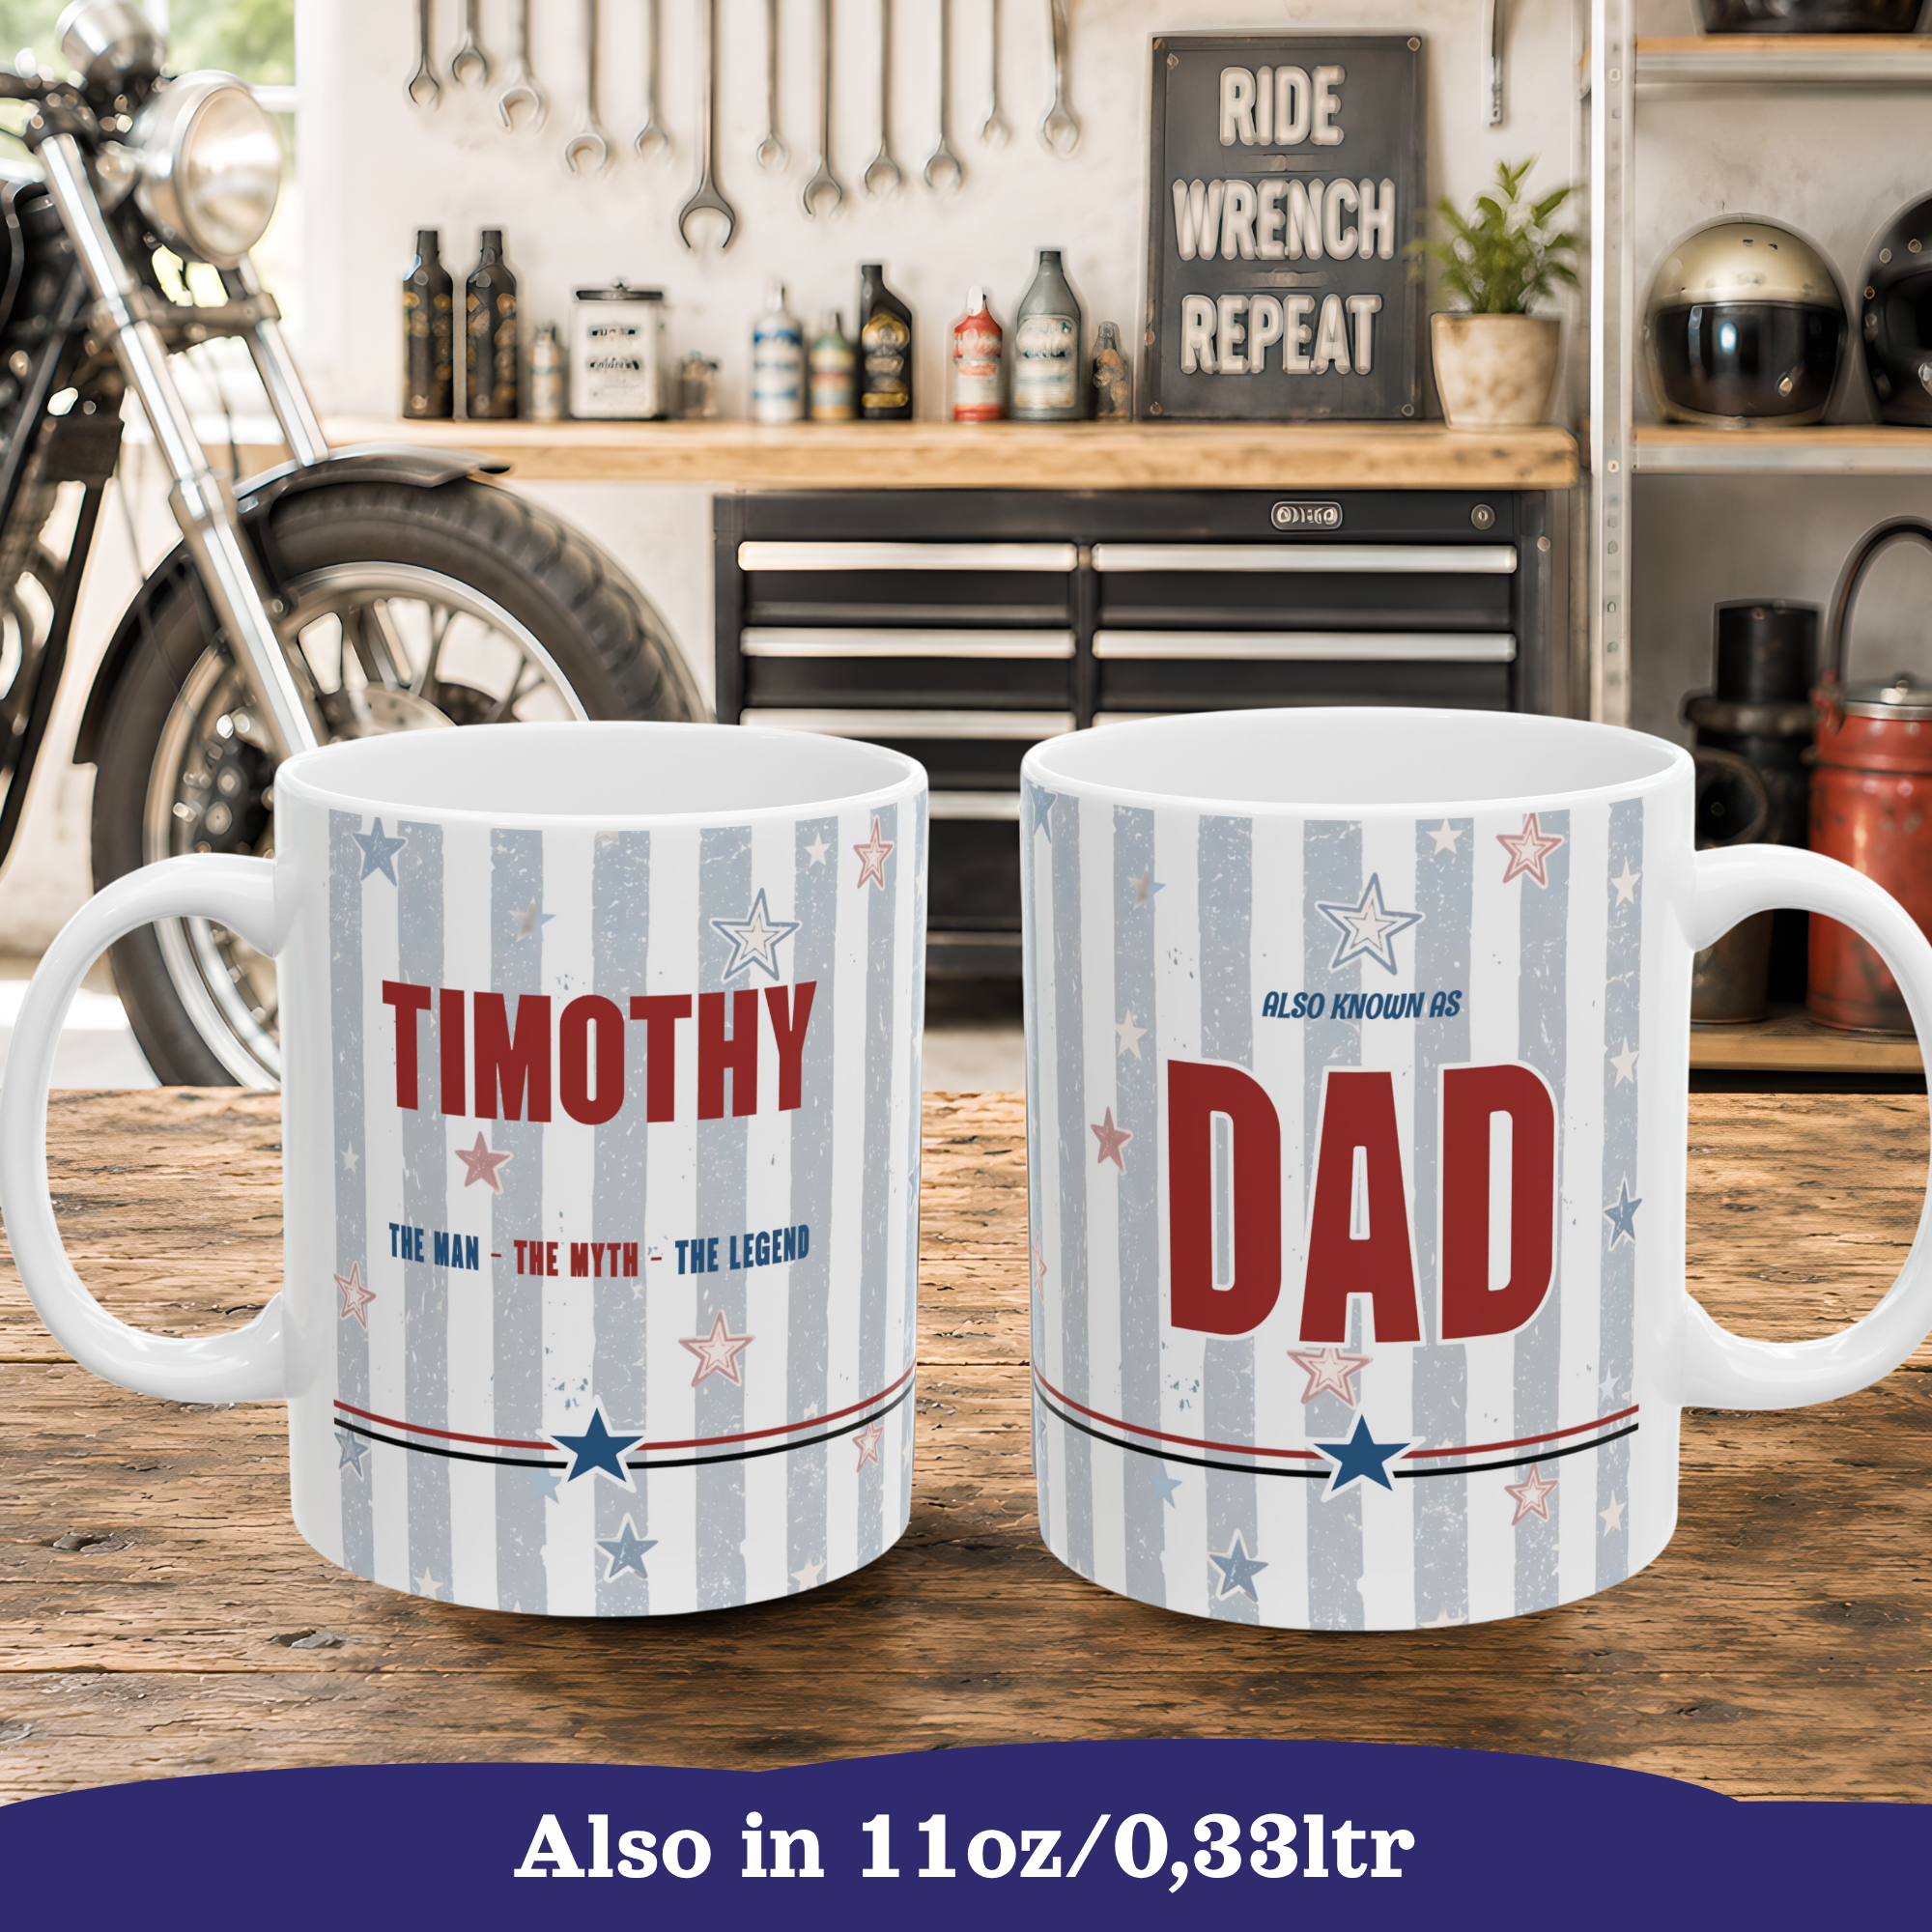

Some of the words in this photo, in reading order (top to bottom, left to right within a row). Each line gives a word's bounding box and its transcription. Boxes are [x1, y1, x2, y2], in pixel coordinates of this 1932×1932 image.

[1219, 65, 1346, 146] RIDE
[1172, 178, 1396, 261] WRENCH
[1180, 294, 1382, 376] REPEAT
[1262, 991, 1325, 1019] ALSO
[1330, 992, 1425, 1020] KNOWN
[1429, 989, 1463, 1018] AS
[382, 980, 817, 1125] TIMOTHY
[1167, 1059, 1554, 1343] DAD
[389, 1222, 425, 1264] THE
[434, 1231, 479, 1271] MAN
[513, 1239, 558, 1277] THE
[570, 1242, 639, 1278] MYTH
[674, 1236, 719, 1275] THE
[729, 1224, 810, 1270] LEGEND
